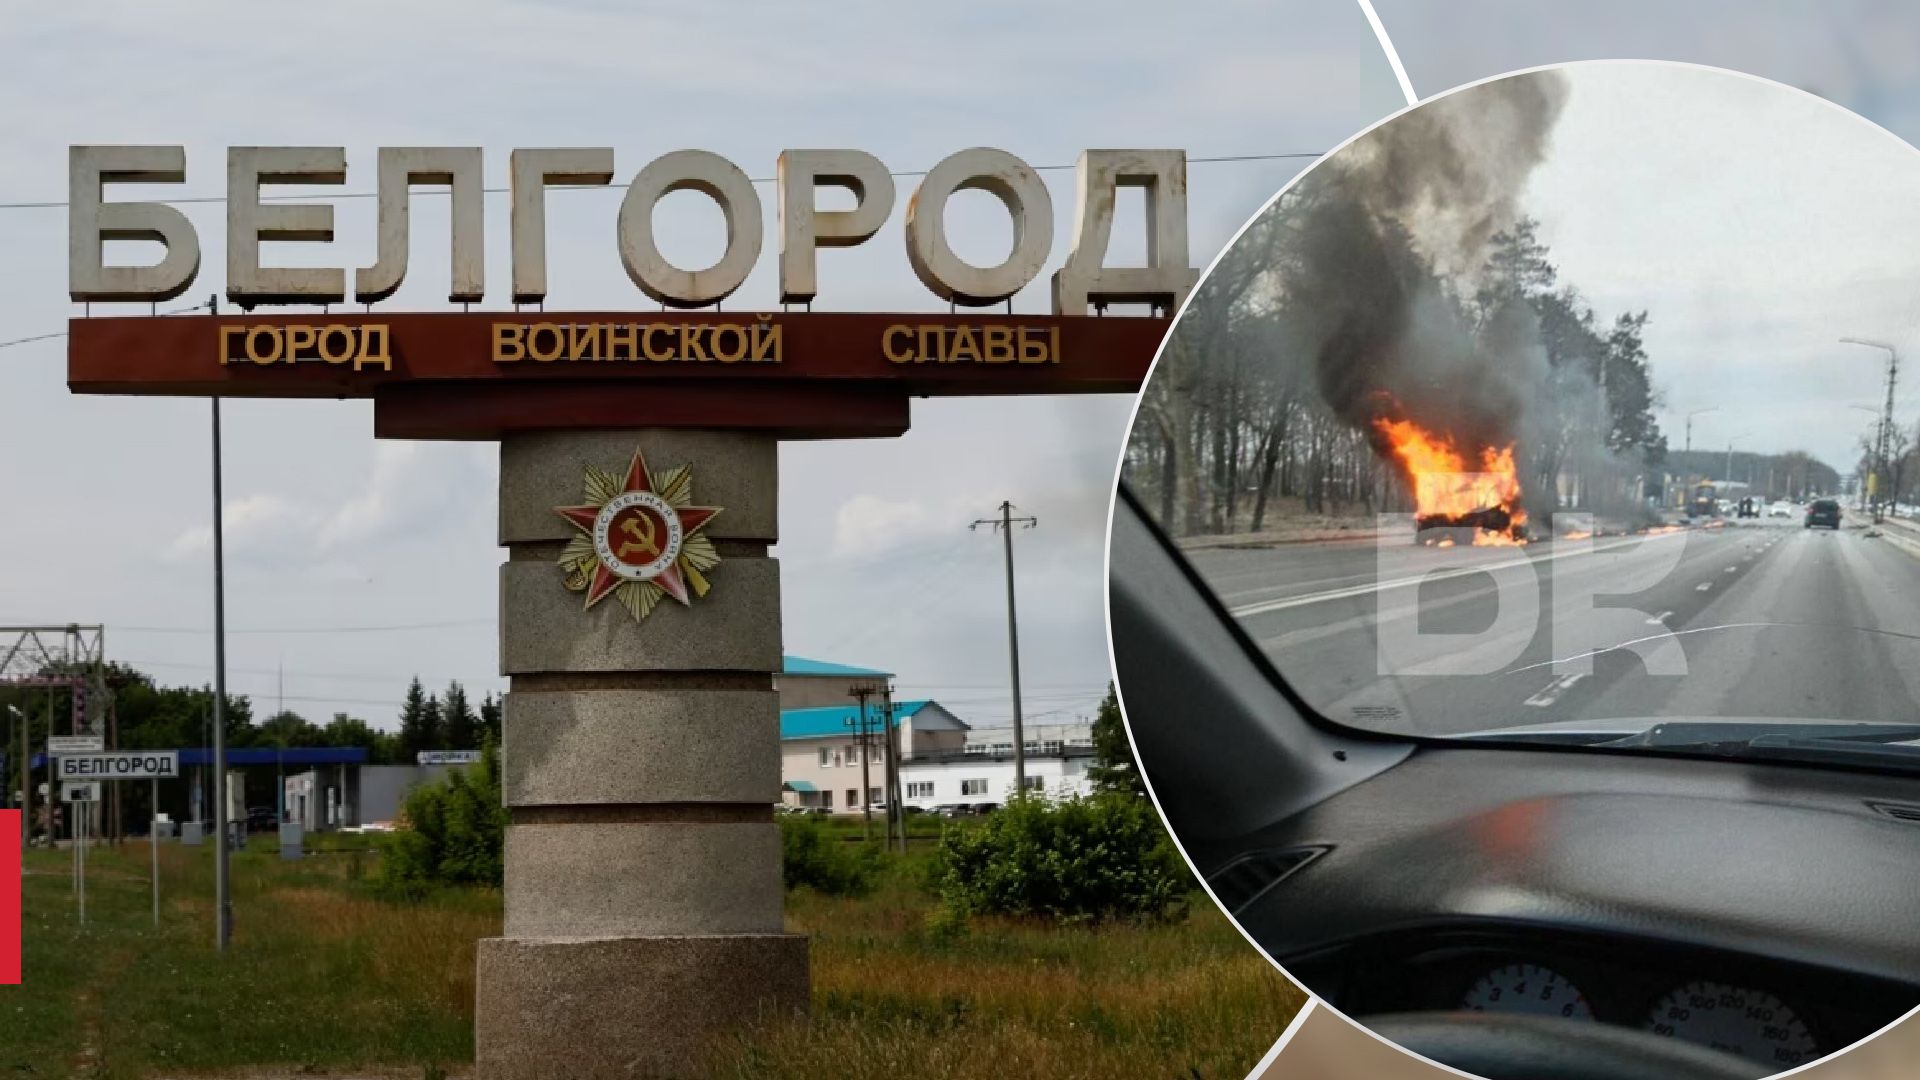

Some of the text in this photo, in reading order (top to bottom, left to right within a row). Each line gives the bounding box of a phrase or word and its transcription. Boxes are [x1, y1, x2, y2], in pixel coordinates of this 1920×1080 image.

[69, 146, 1200, 317] БЕЛГОРОД
[219, 314, 1060, 371] ГОРОД ВОИНСКОЙ СЛАВЫ
[64, 756, 172, 775] БЕЛГОРОД
[1488, 986, 1503, 1002] 3
[1513, 980, 1528, 995] 4
[1540, 984, 1555, 1000] 5
[1562, 1003, 1576, 1018] 6
[1668, 1007, 1690, 1022] 80
[1745, 1006, 1774, 1023] 140
[1762, 1026, 1790, 1042] 160
